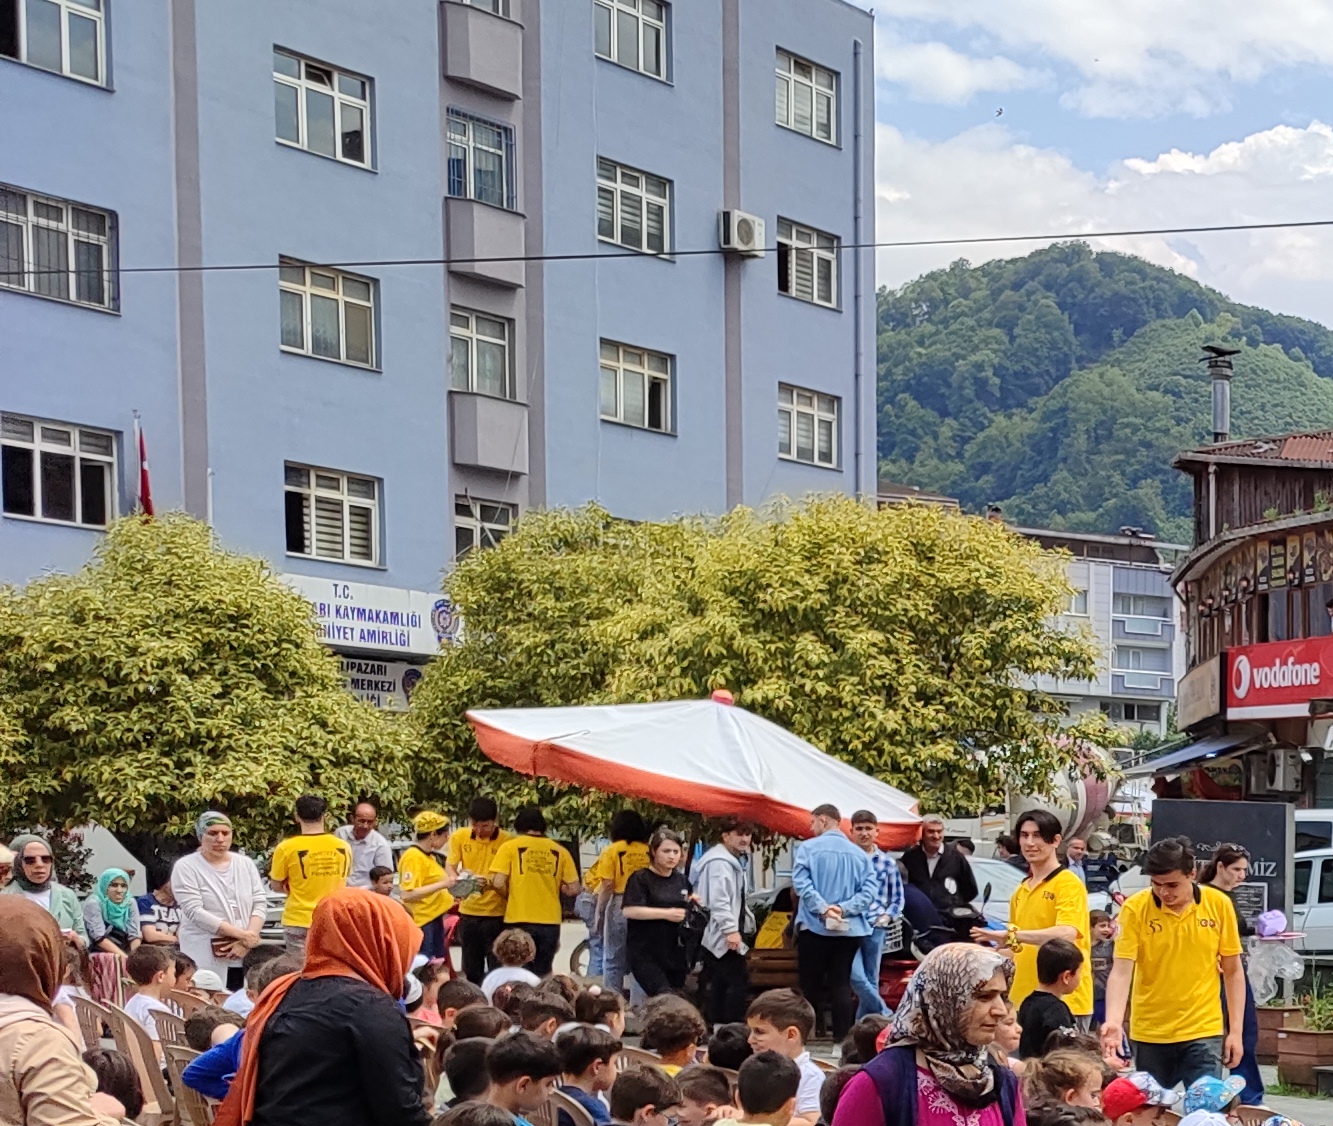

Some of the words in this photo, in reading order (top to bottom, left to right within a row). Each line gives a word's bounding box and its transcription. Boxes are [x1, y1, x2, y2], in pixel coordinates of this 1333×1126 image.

[333, 583, 354, 600] T.C.
[335, 603, 422, 630] KAYMAKAMLIĞI
[359, 627, 411, 647] AMİRLİĞİ
[1252, 655, 1321, 689] vodafone
[350, 678, 397, 693] MERKEZİ
